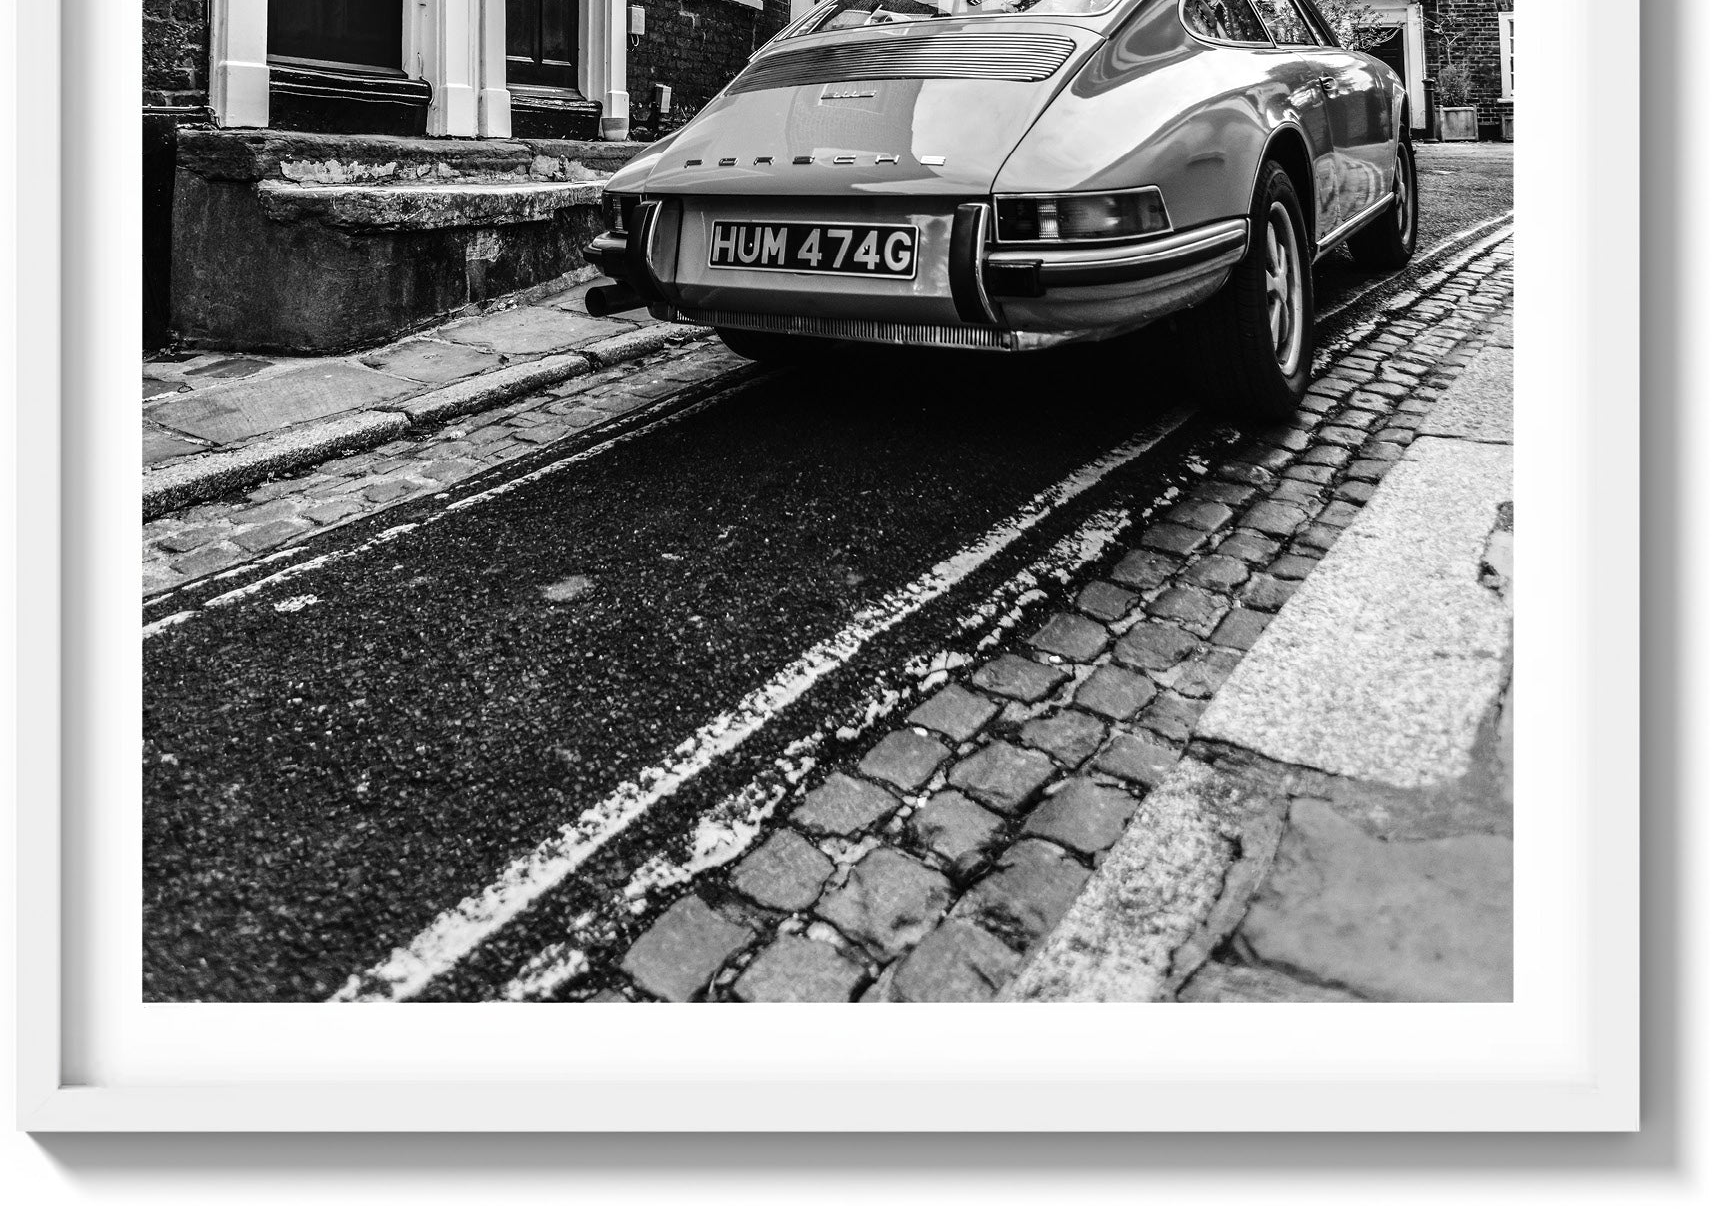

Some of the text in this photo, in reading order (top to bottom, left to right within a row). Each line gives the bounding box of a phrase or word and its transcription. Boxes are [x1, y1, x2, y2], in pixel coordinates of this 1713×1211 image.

[684, 154, 946, 169] PORSCHE
[712, 225, 913, 272] HUM 474G
